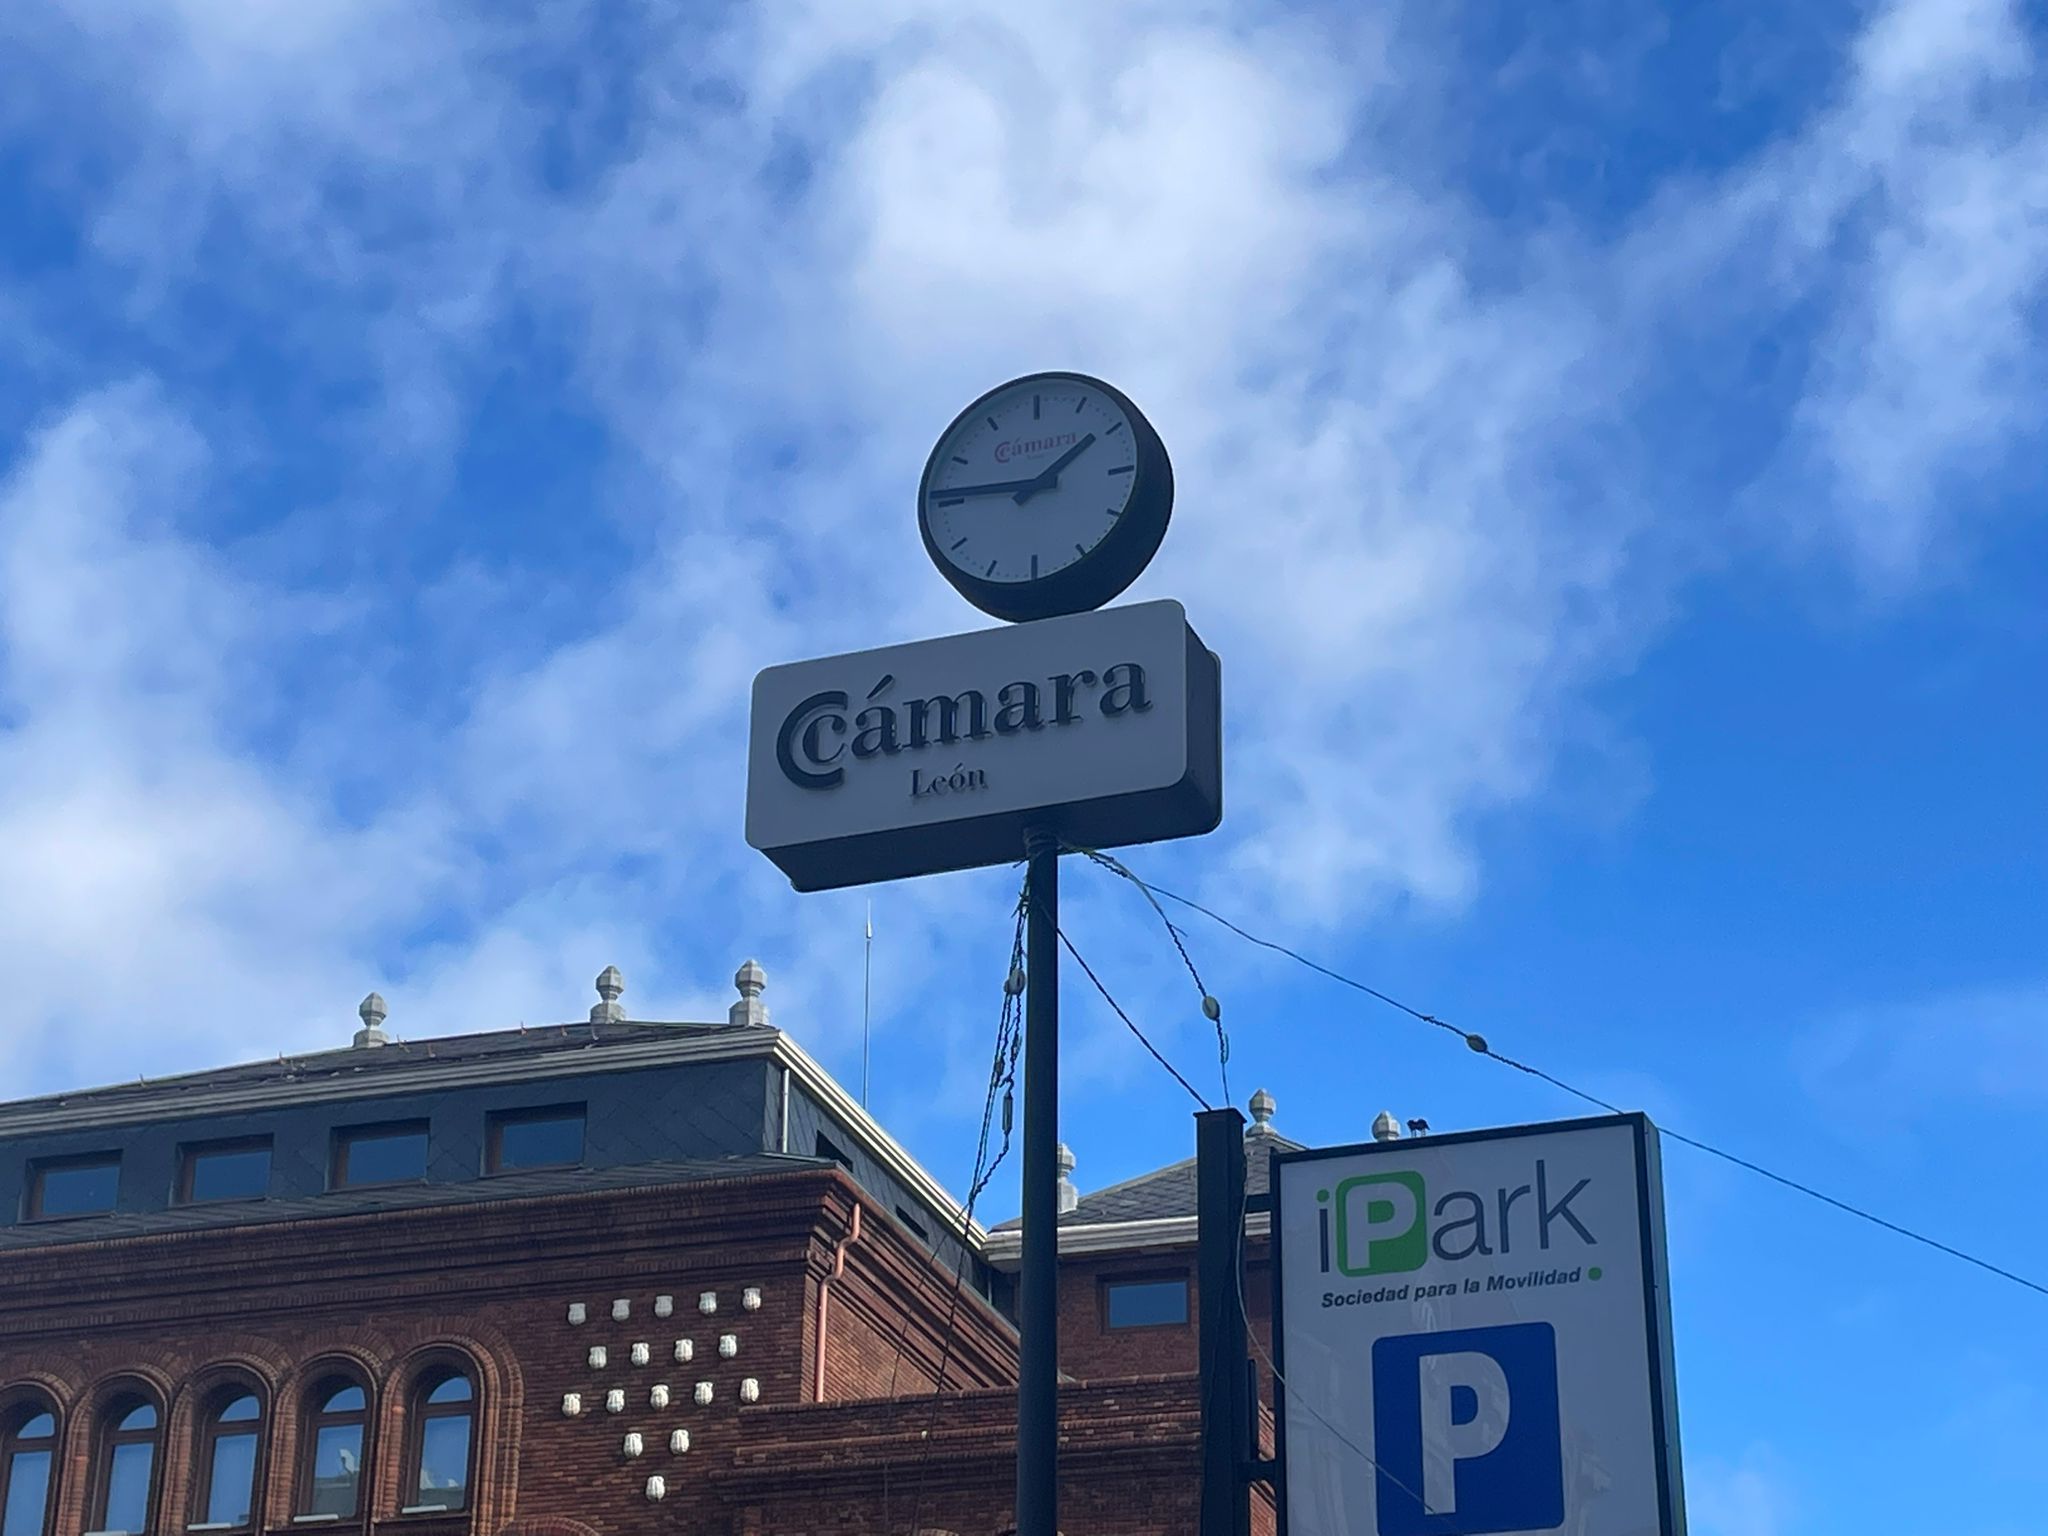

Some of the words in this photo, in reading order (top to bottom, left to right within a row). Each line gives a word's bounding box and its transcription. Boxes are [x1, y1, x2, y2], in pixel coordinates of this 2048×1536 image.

[910, 763, 988, 798] León
[1316, 1159, 1598, 1275] iPark
[1321, 1285, 1410, 1309] Sociedad
[1413, 1280, 1458, 1301] para
[1463, 1277, 1481, 1295] la
[1486, 1266, 1582, 1292] Movilidad
[1419, 1350, 1511, 1516] P
